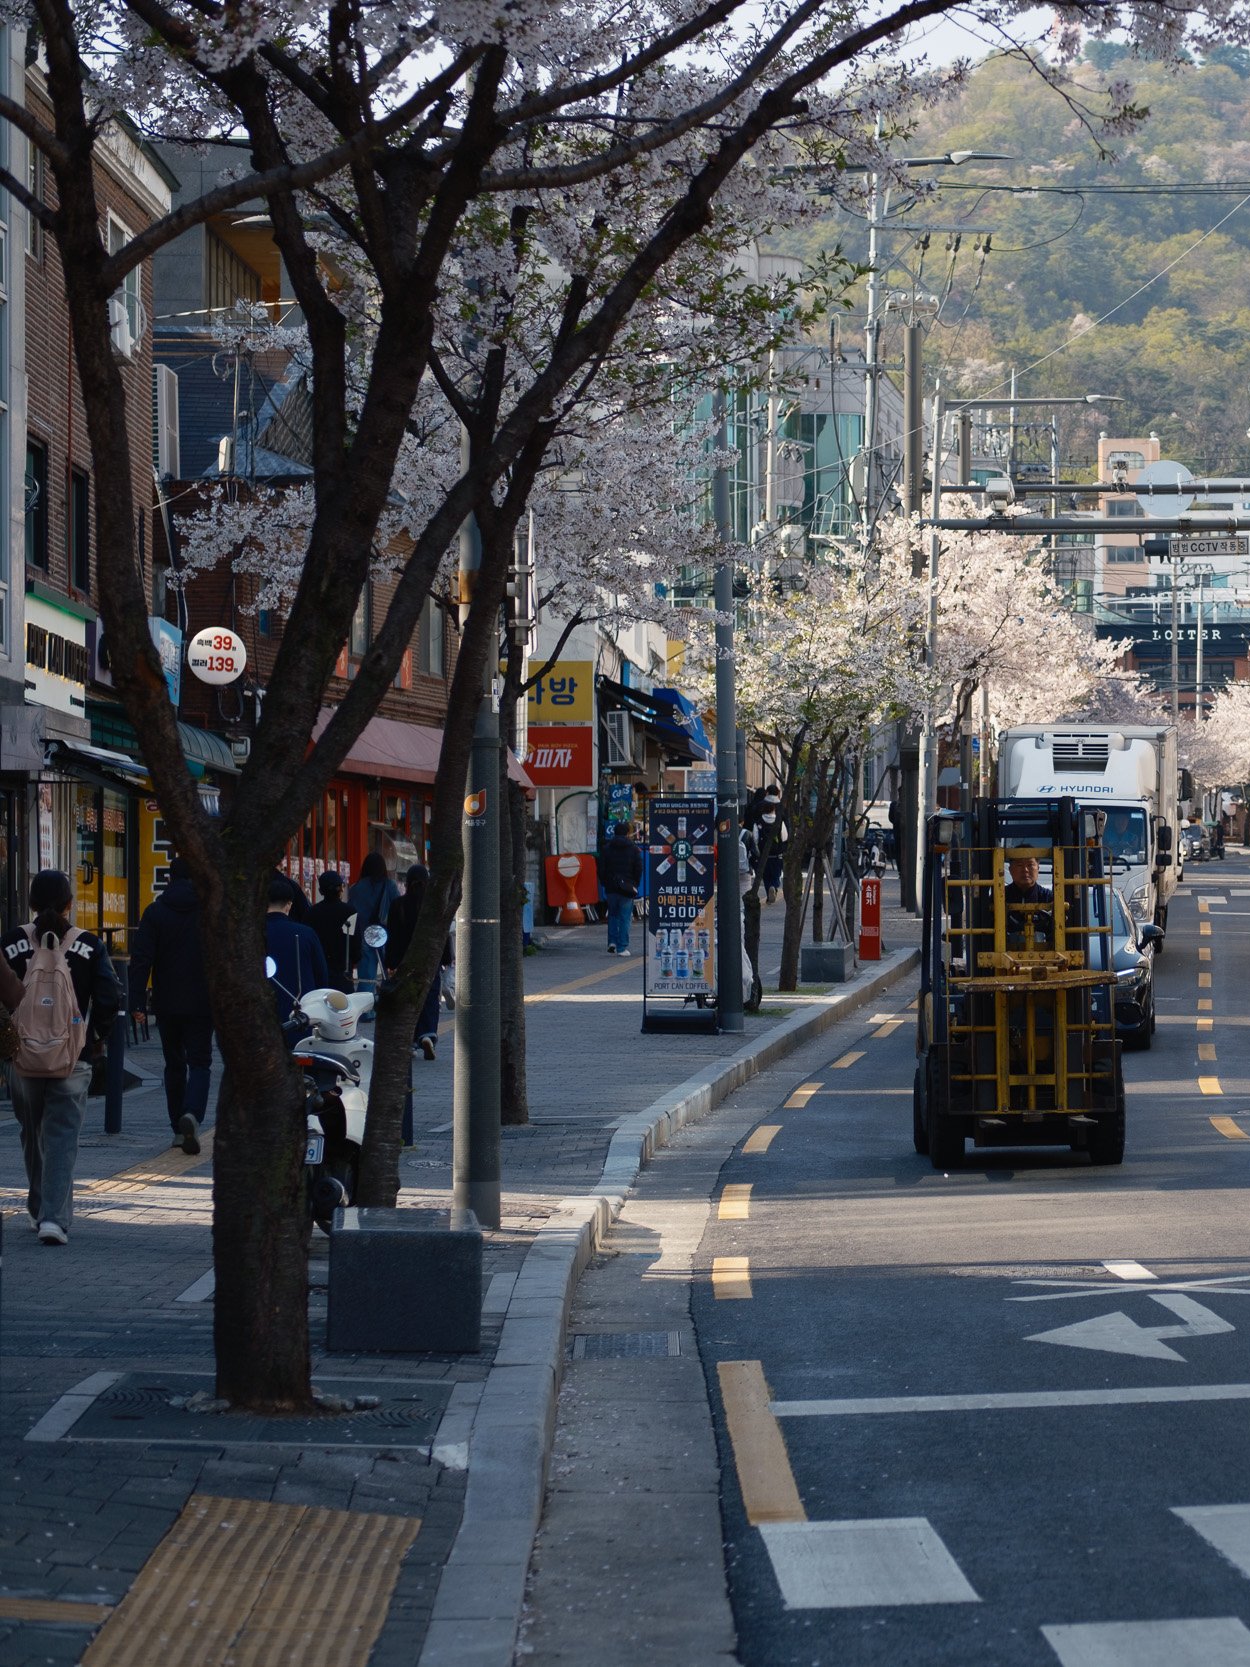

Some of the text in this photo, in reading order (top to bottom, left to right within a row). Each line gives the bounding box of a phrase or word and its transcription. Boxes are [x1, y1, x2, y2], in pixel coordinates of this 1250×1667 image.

[1172, 541, 1247, 553] 방범 CCTV 작동중
[1152, 629, 1222, 641] LOITER
[1060, 785, 1114, 794] HYUNDAI
[658, 886, 706, 895] 스페셜티 원두
[865, 884, 873, 906] 소화기
[657, 895, 706, 906] 아메리카노
[654, 982, 709, 990] PORT CAN COFFEE
